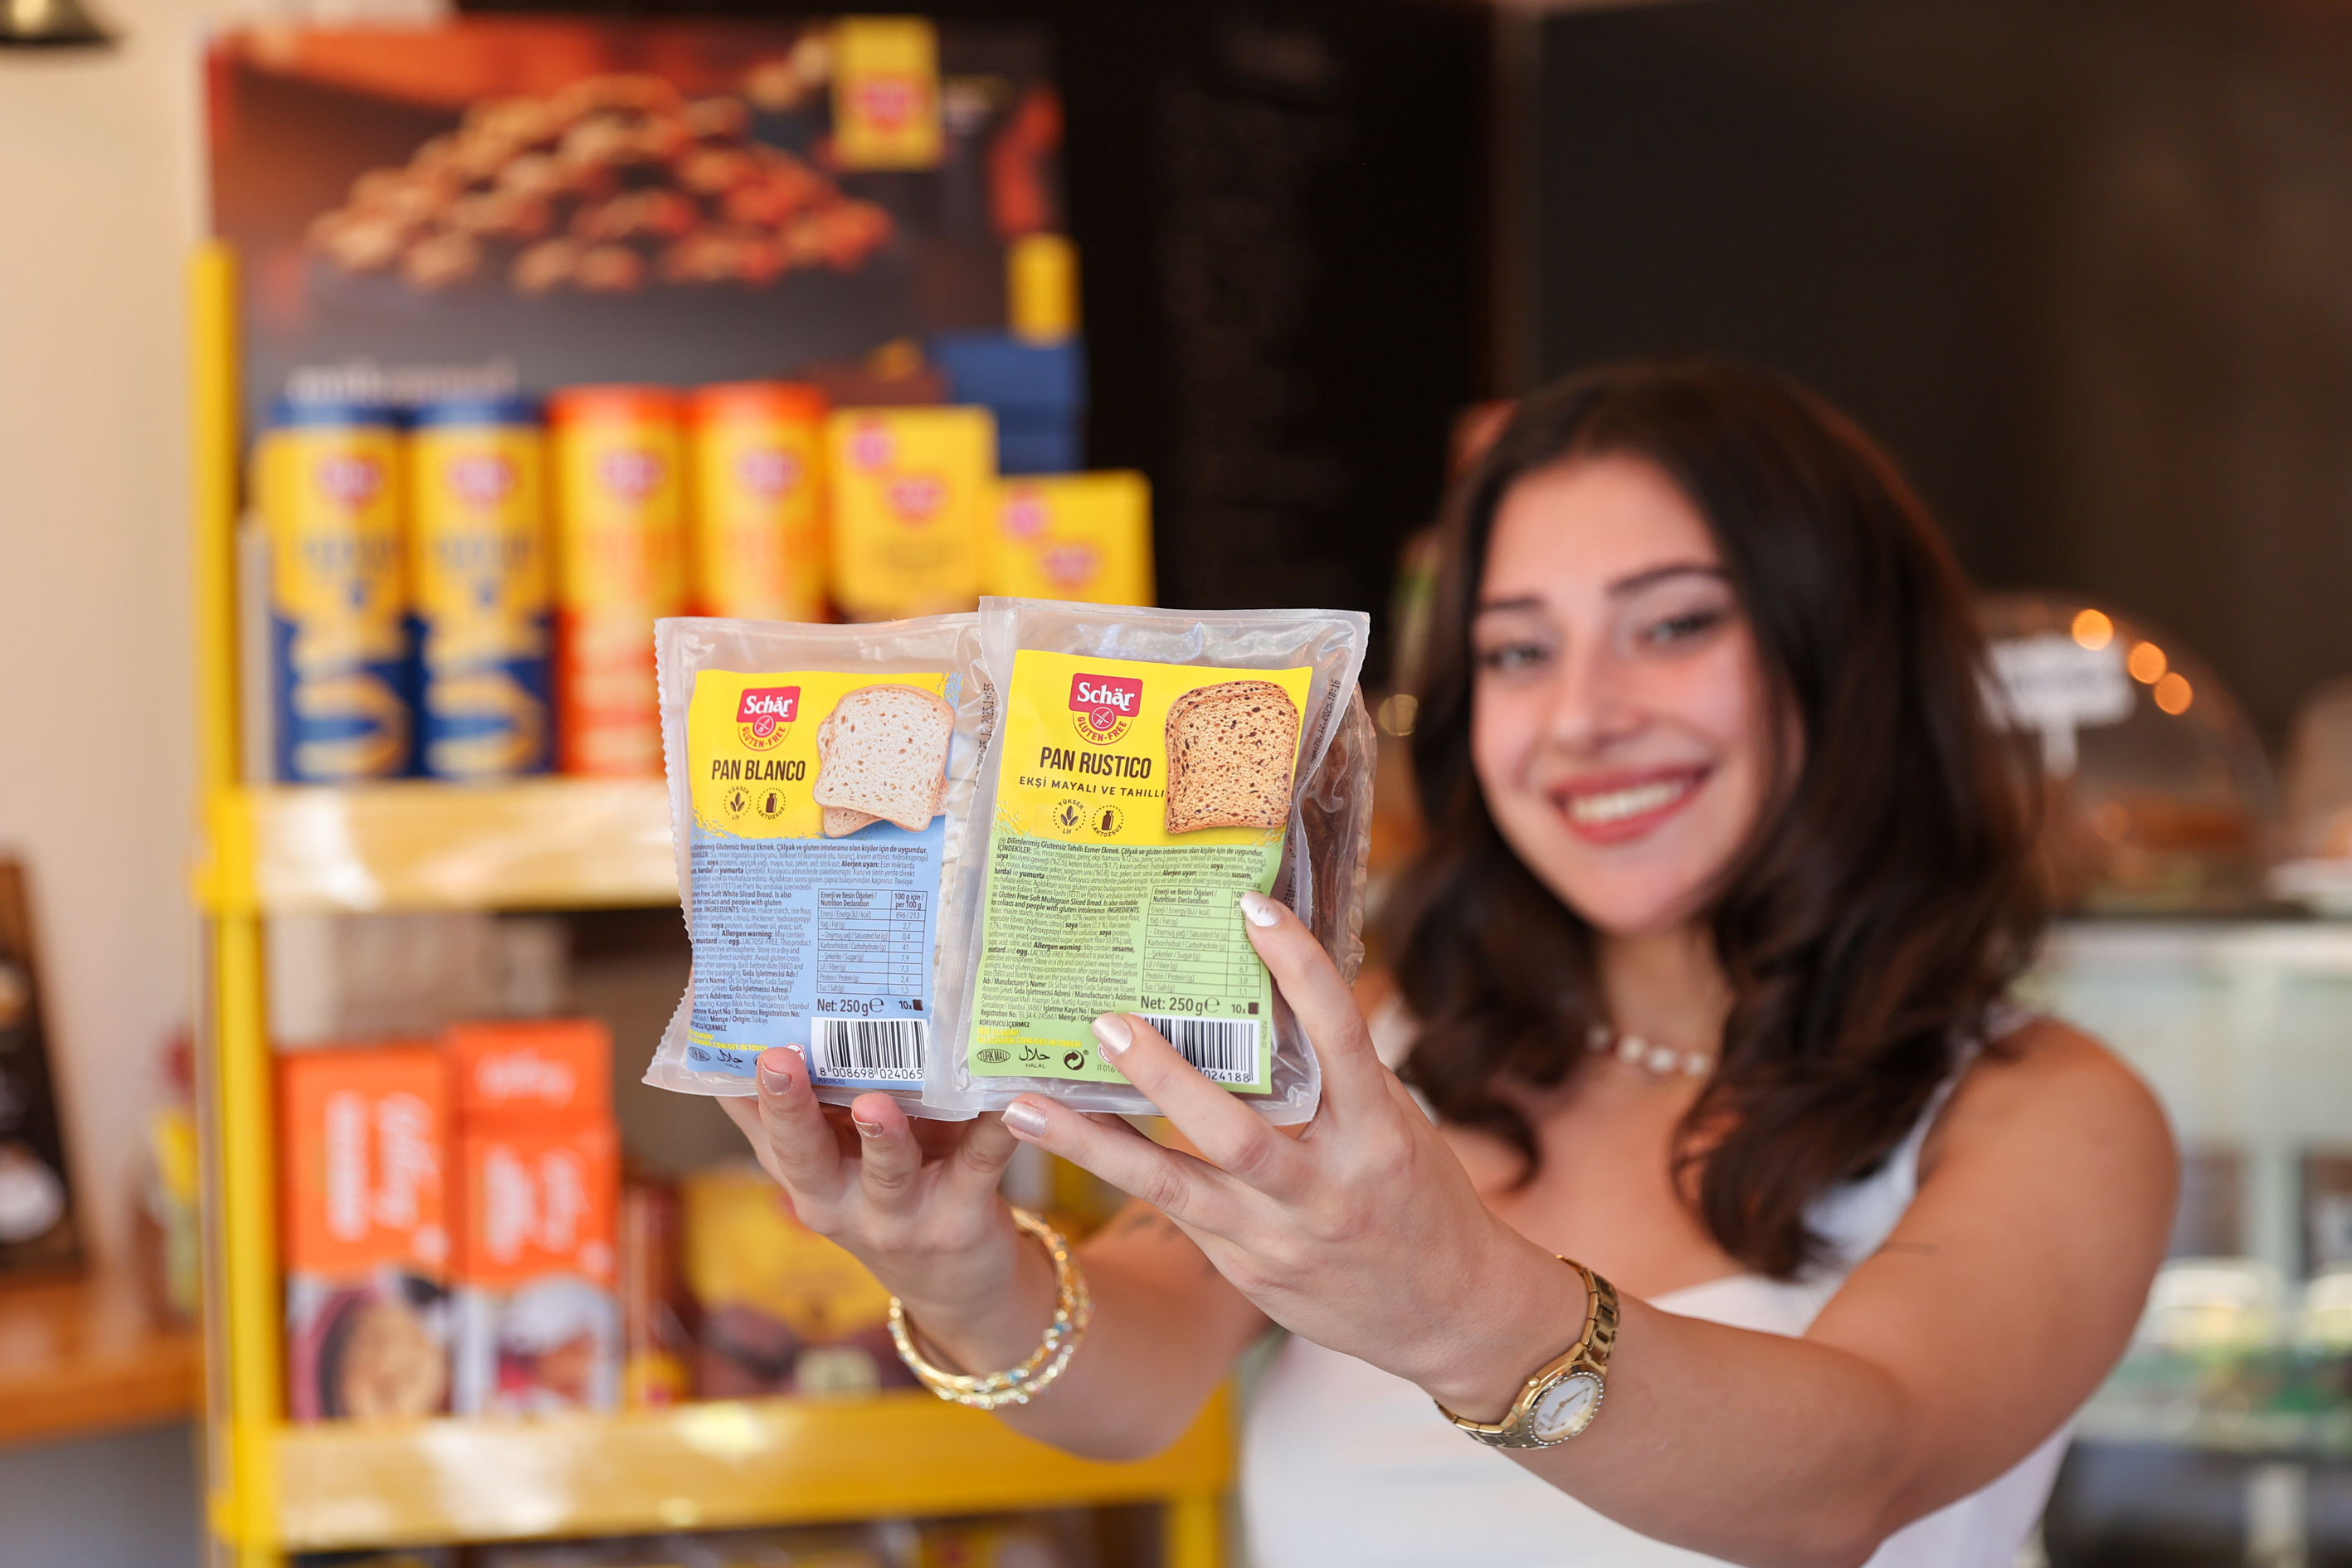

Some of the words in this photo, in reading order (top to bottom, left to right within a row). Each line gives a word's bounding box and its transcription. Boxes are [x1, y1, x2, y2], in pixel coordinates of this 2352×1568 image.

[1078, 682, 1135, 711] Schär
[744, 695, 792, 717] Schär
[1078, 717, 1127, 742] GLUTEN-FREE
[743, 727, 786, 747] GLUTEN-FREE
[1040, 747, 1074, 771] PAN
[1079, 752, 1152, 778] RUSTICO
[712, 760, 741, 780] PAN
[745, 760, 806, 781] BLANCO
[728, 786, 750, 795] YÜKSEK
[1020, 777, 1047, 786] EKŞİ
[1052, 781, 1096, 793] MAYALI
[1102, 786, 1115, 795] VE
[1121, 788, 1164, 797] TAHILLI
[1058, 799, 1084, 810] YÜKSEK
[757, 806, 785, 820] LAKTOZSUZ
[1092, 823, 1122, 837] LAKTOZSUZ
[741, 844, 755, 852] Beyaz
[777, 844, 795, 853] Çölyak
[803, 844, 820, 853] gluten
[997, 845, 1032, 855] İÇİNDEKİLER:
[1007, 838, 1040, 849] Dilimlenmiş
[1041, 841, 1066, 850] Glutensiz
[1121, 848, 1137, 856] Çölyak
[1146, 849, 1161, 857] gluten
[856, 891, 874, 901] Öğeleri
[911, 894, 920, 902] için
[1155, 889, 1169, 897] Enerji
[1194, 888, 1214, 897] Öğeleri
[732, 899, 750, 908] people
[765, 899, 782, 908] gluten
[1041, 896, 1069, 905] Multigrain
[1059, 905, 1077, 913] gluten
[817, 999, 837, 1011] Net:
[840, 1000, 859, 1012] 250
[899, 1001, 912, 1010] 10x
[1141, 996, 1165, 1010] Net:
[1170, 998, 1193, 1011] 250
[1231, 1004, 1246, 1014] 10x
[704, 1023, 727, 1032] İÇERMEZ
[978, 1027, 990, 1035] BİZE
[977, 1036, 1081, 1047] GO.SCHAER.COM/GET-IN-TOUCH
[718, 1049, 743, 1063] حلال
[1019, 1045, 1050, 1061] حلال
[820, 1067, 825, 1076] 8
[833, 1069, 874, 1078] 008698
[880, 1069, 923, 1079] 024065
